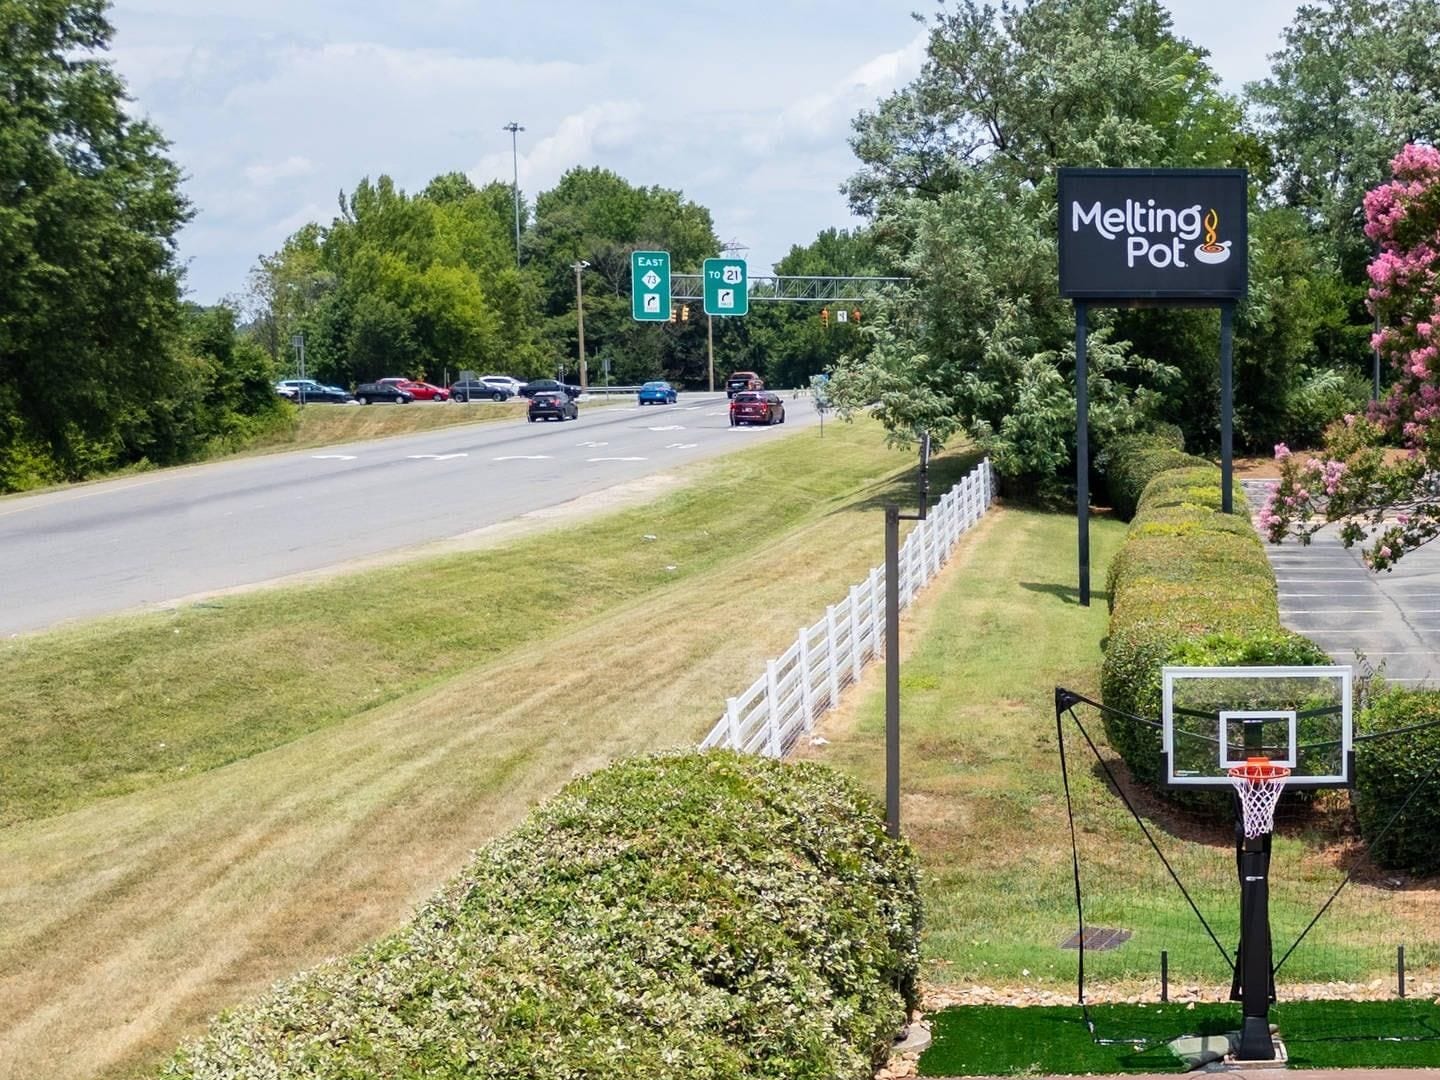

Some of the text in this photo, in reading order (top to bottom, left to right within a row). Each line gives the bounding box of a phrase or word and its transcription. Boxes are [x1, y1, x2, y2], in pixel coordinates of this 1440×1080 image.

[1072, 199, 1202, 240] Melting
[1127, 236, 1186, 268] Pot
[638, 257, 664, 267] EAST
[647, 275, 657, 285] 73
[709, 270, 738, 281] TO 21
